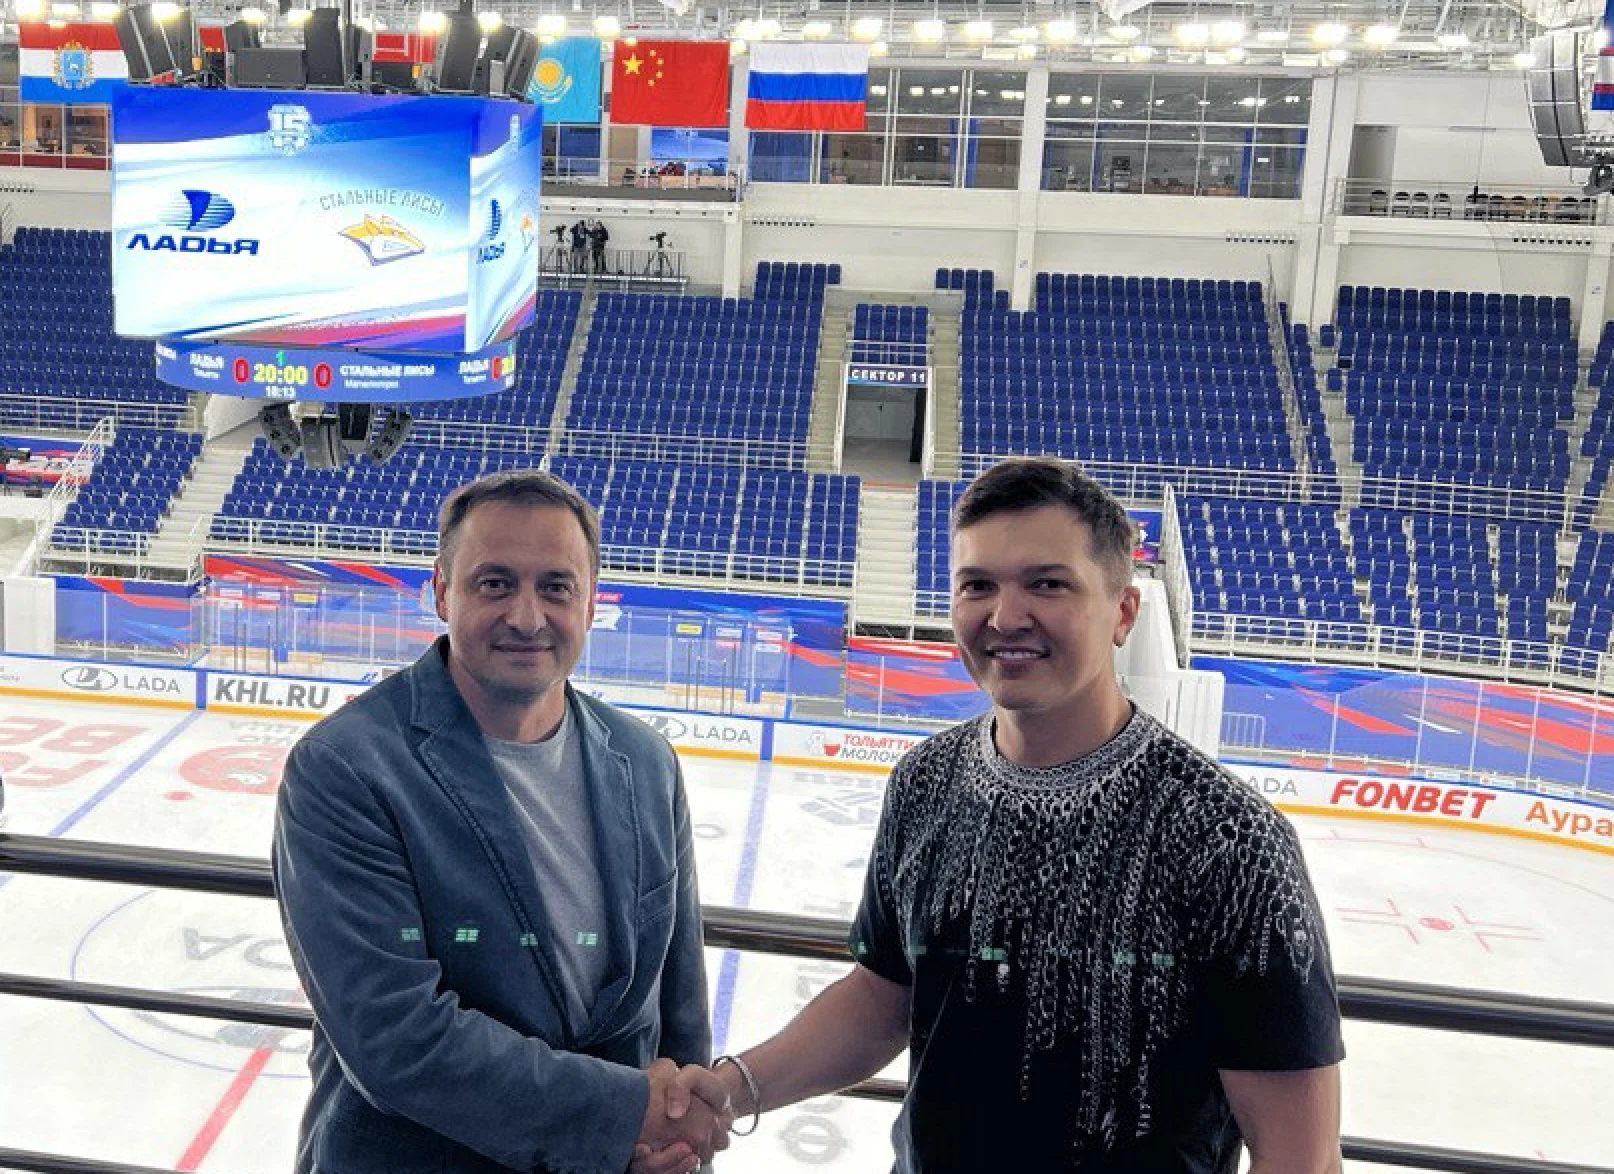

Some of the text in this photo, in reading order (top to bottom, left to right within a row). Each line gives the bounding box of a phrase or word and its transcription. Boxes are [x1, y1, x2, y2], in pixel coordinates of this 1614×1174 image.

[319, 189, 445, 217] СТАЛЬНЫЕ ЛИСЫ
[233, 357, 249, 383] 0
[253, 363, 308, 385] 20:00
[313, 362, 332, 389] 0
[851, 369, 926, 383] СЕКТОР 11
[123, 675, 181, 694] LADA
[214, 677, 331, 709] KHL.RU
[693, 723, 753, 743] LADA
[844, 733, 916, 751] ТОЛЬЯТТИ
[840, 747, 900, 763] МОЛОК
[1248, 775, 1299, 797] ADA
[1330, 779, 1496, 818] FONBET
